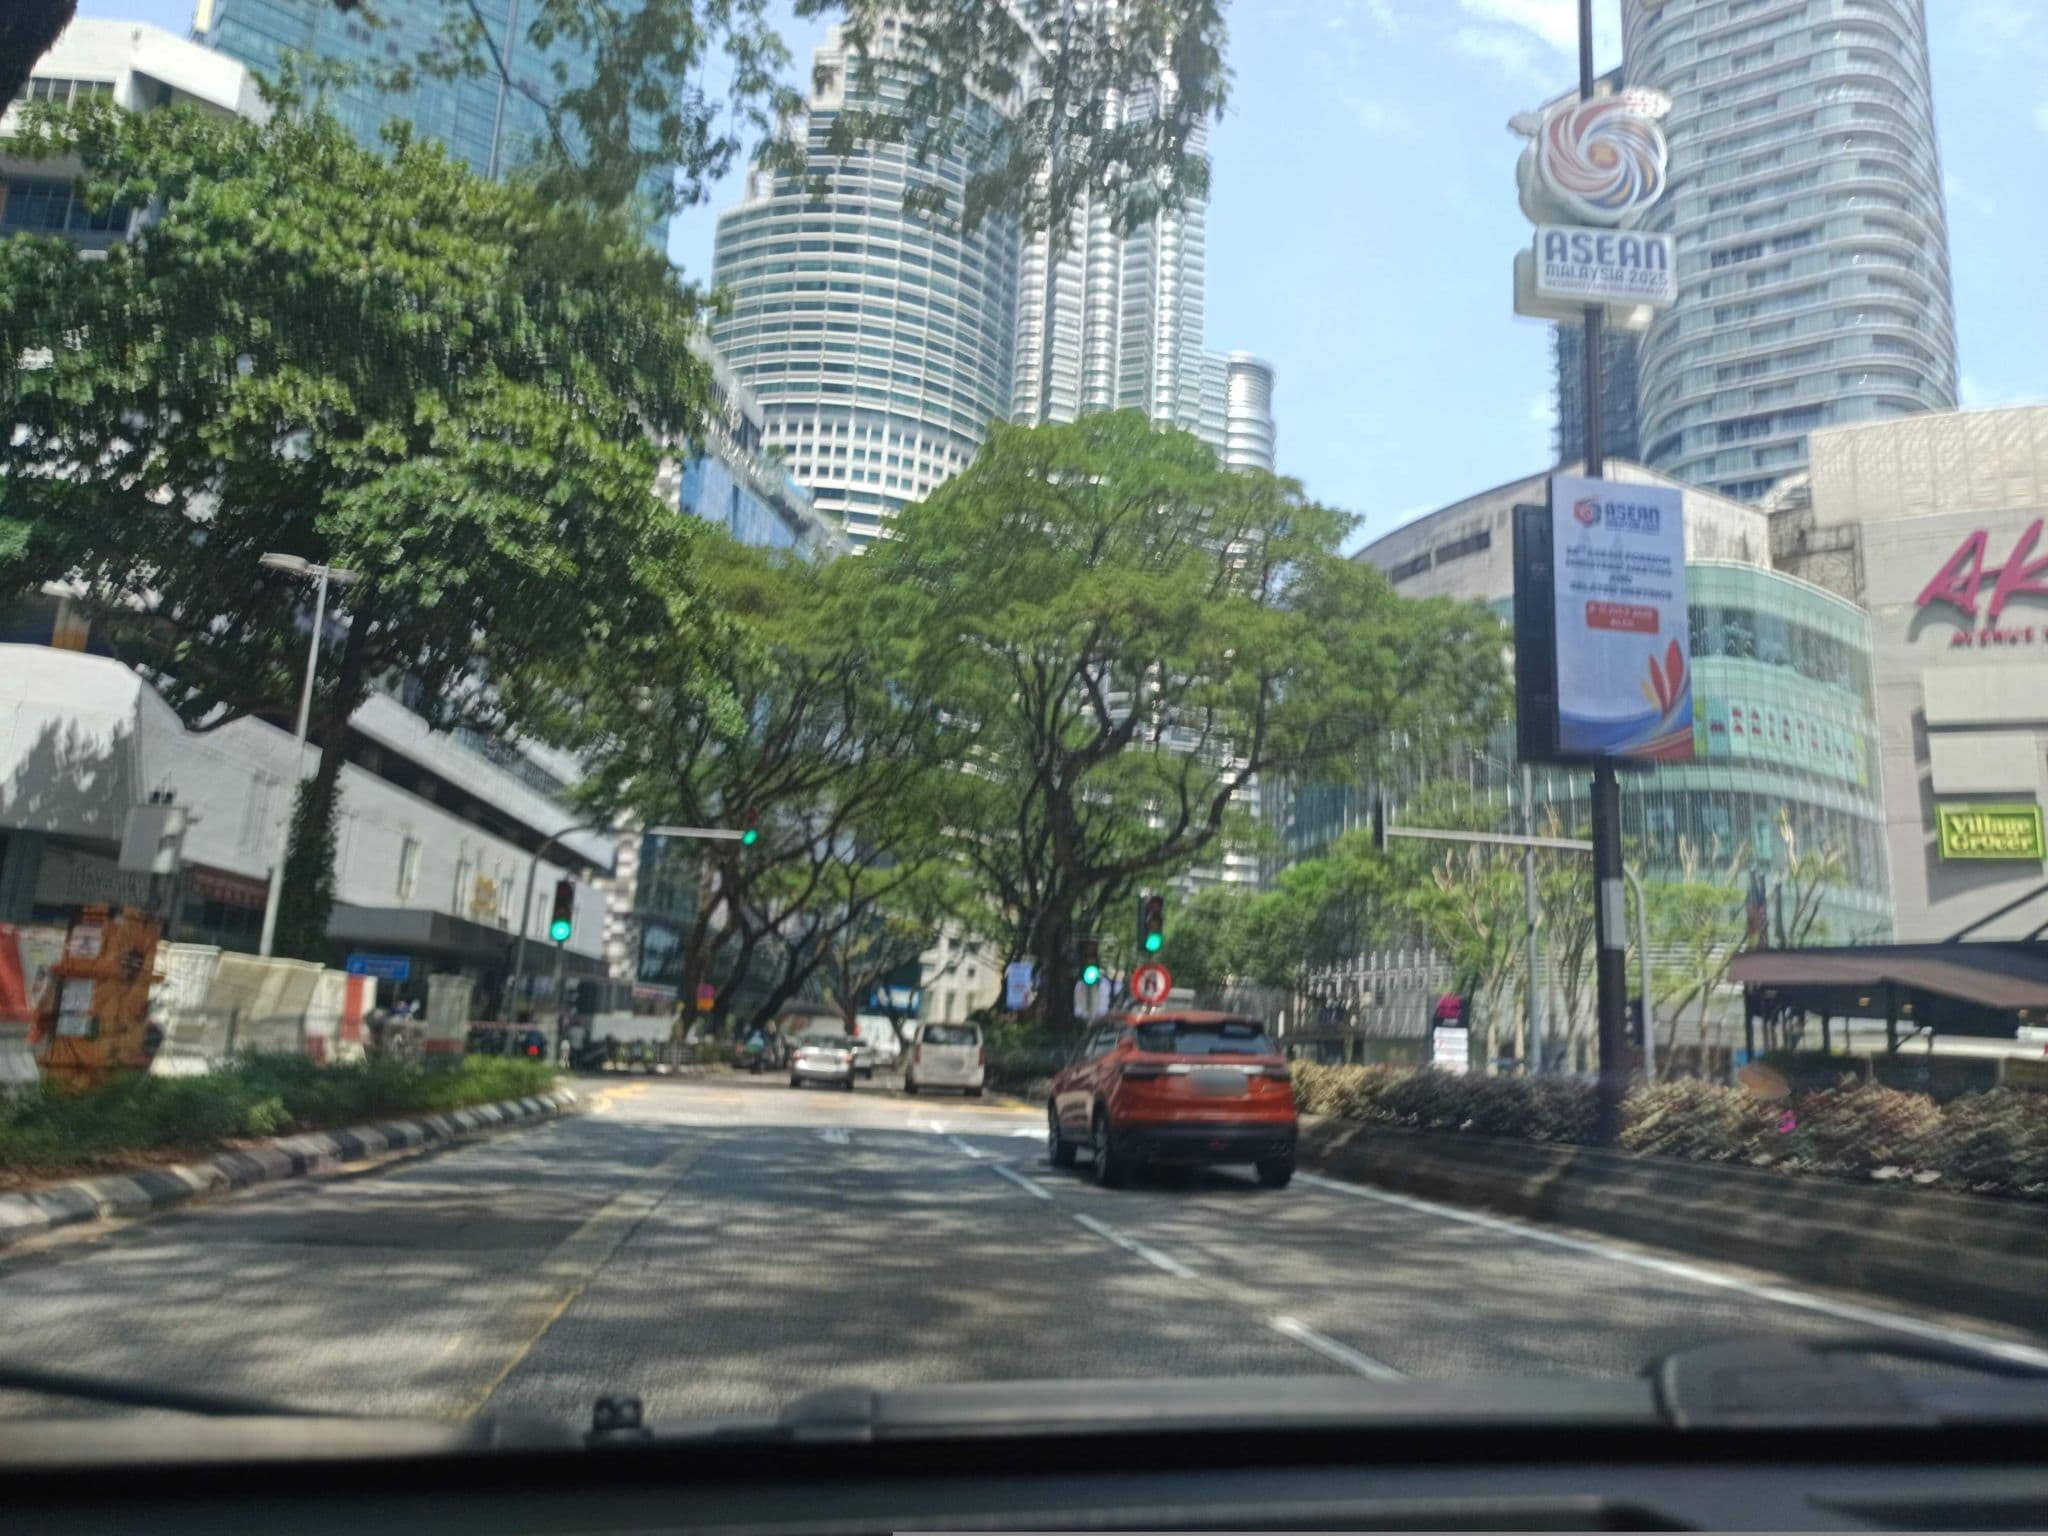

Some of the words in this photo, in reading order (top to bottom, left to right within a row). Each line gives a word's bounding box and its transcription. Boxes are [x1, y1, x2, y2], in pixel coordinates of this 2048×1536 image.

[1545, 230, 1667, 270] ASEAN
[1630, 269, 1669, 286] 2025
[1605, 502, 1660, 524] ASEAN
[1951, 815, 2031, 839] Village
[1951, 834, 2033, 850] Grocer
